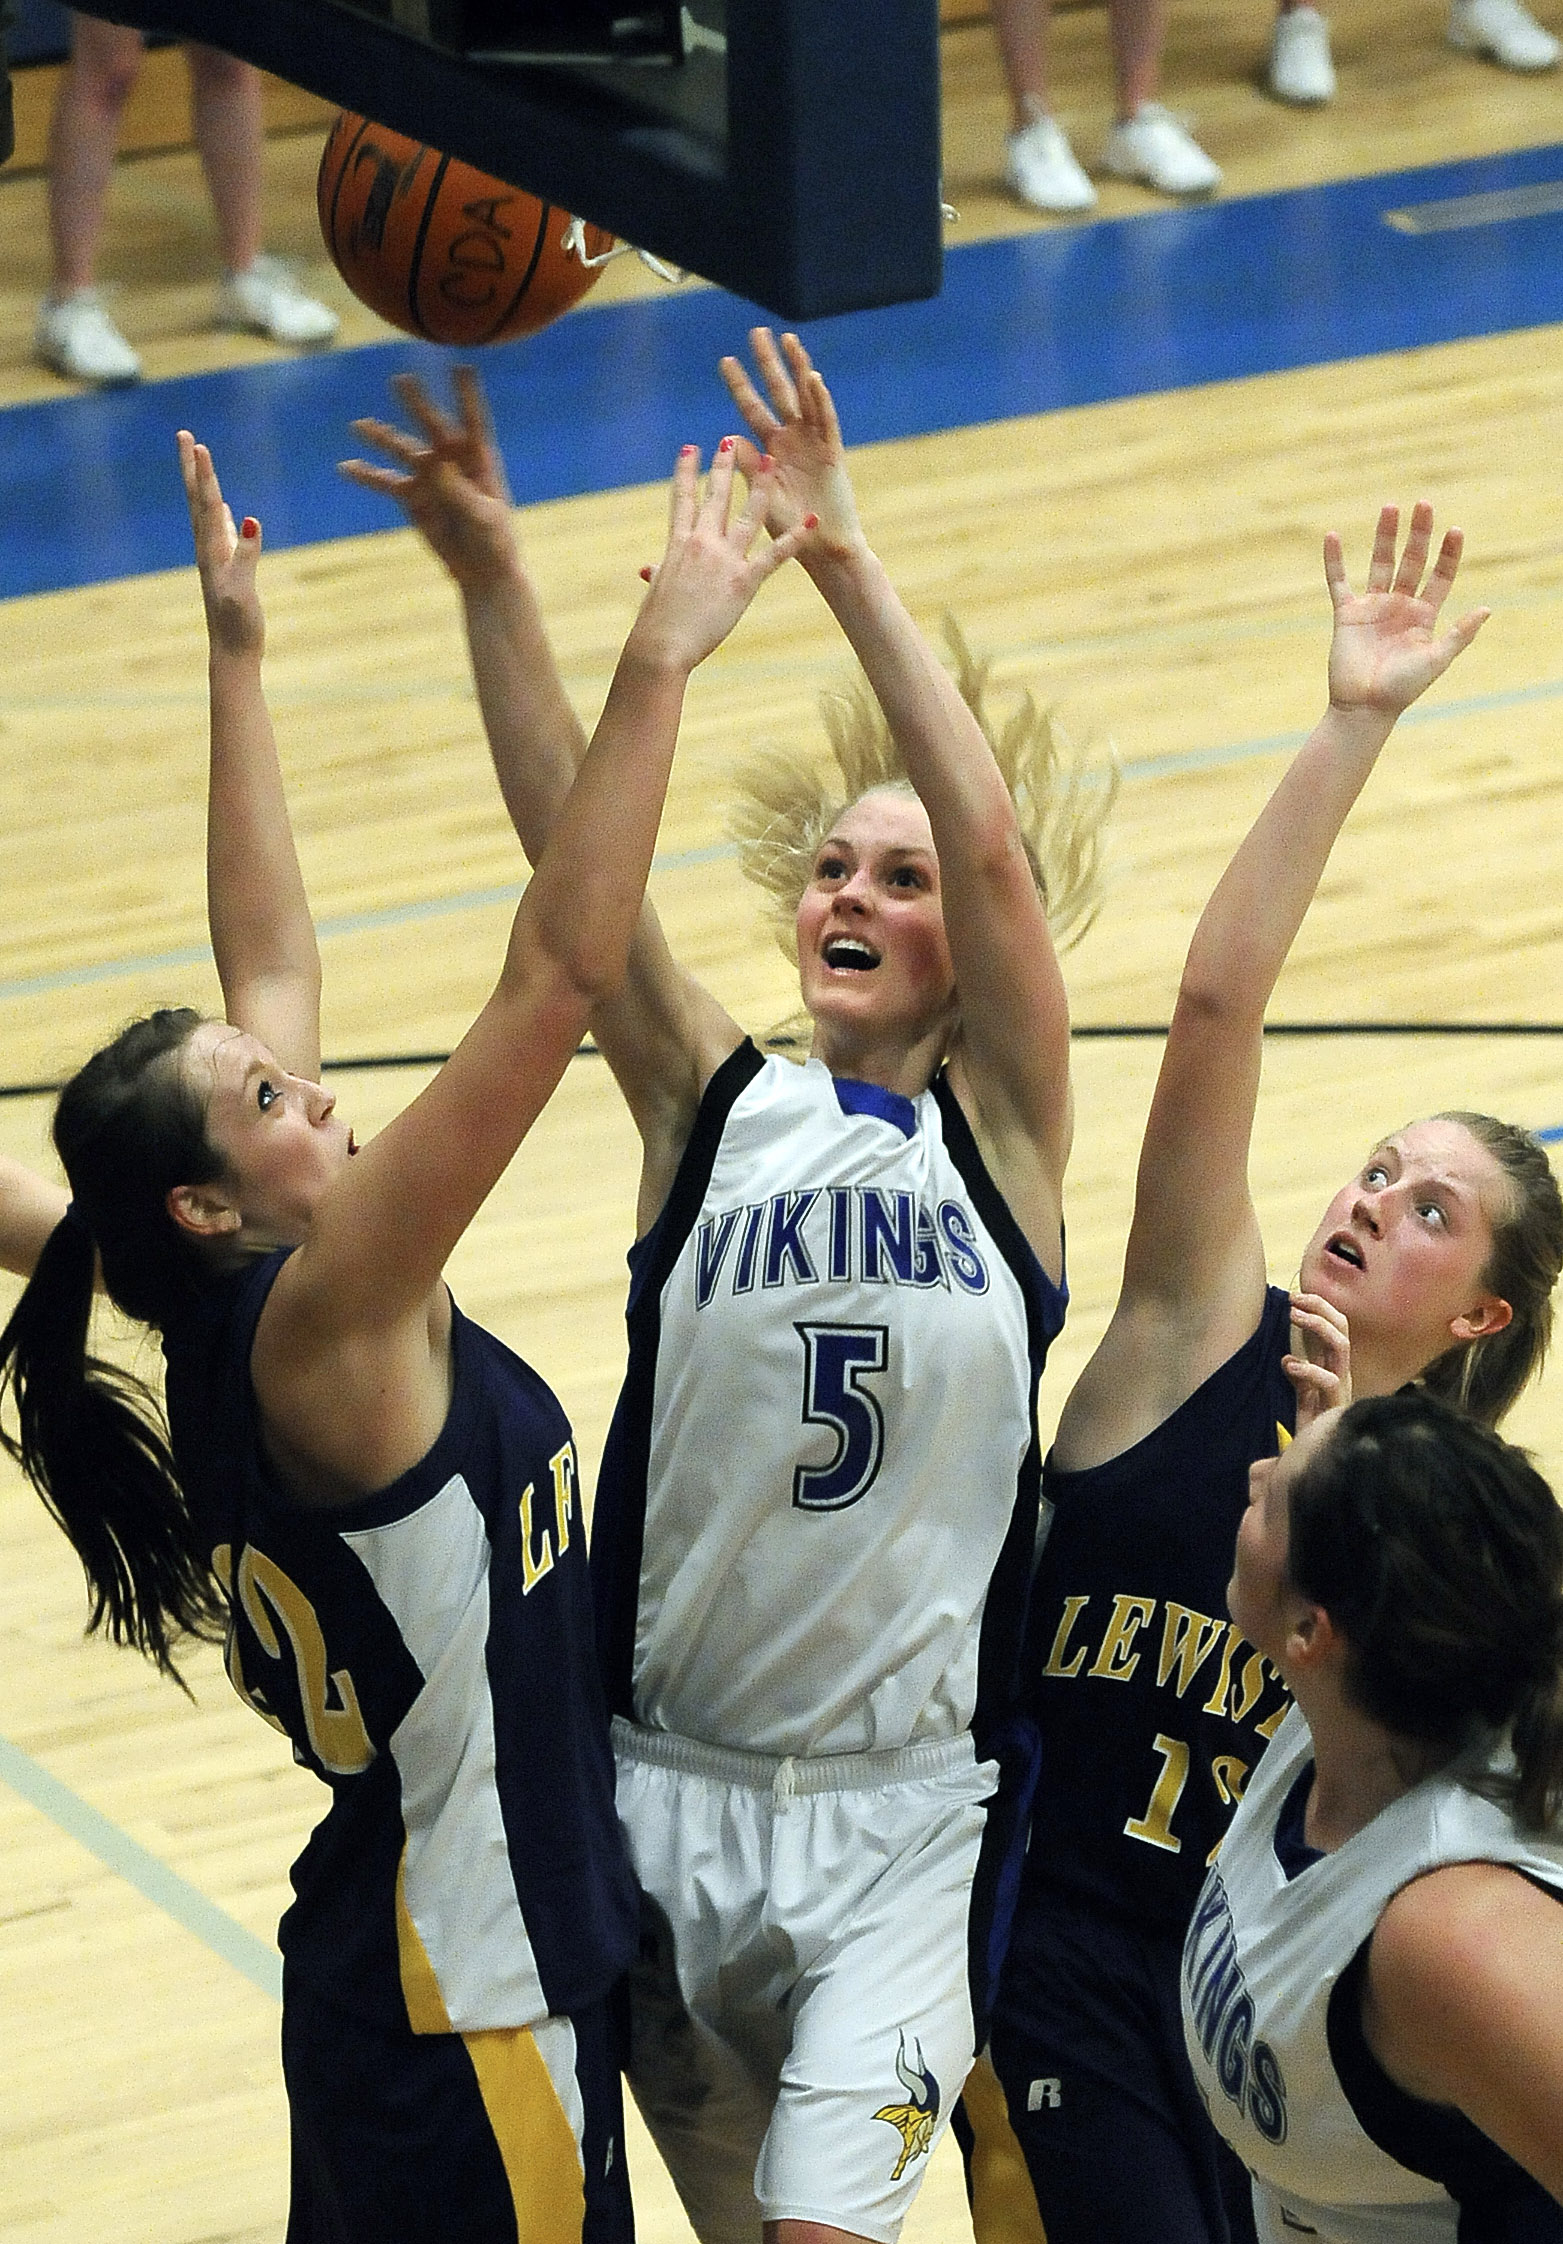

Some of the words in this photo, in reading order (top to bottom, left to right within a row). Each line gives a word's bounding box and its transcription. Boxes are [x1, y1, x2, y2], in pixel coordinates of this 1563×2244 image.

[439, 196, 514, 308] CDA
[696, 1185, 991, 1312] VIKINGS
[792, 1321, 889, 1512] 5
[1027, 2077, 1062, 2112] R
